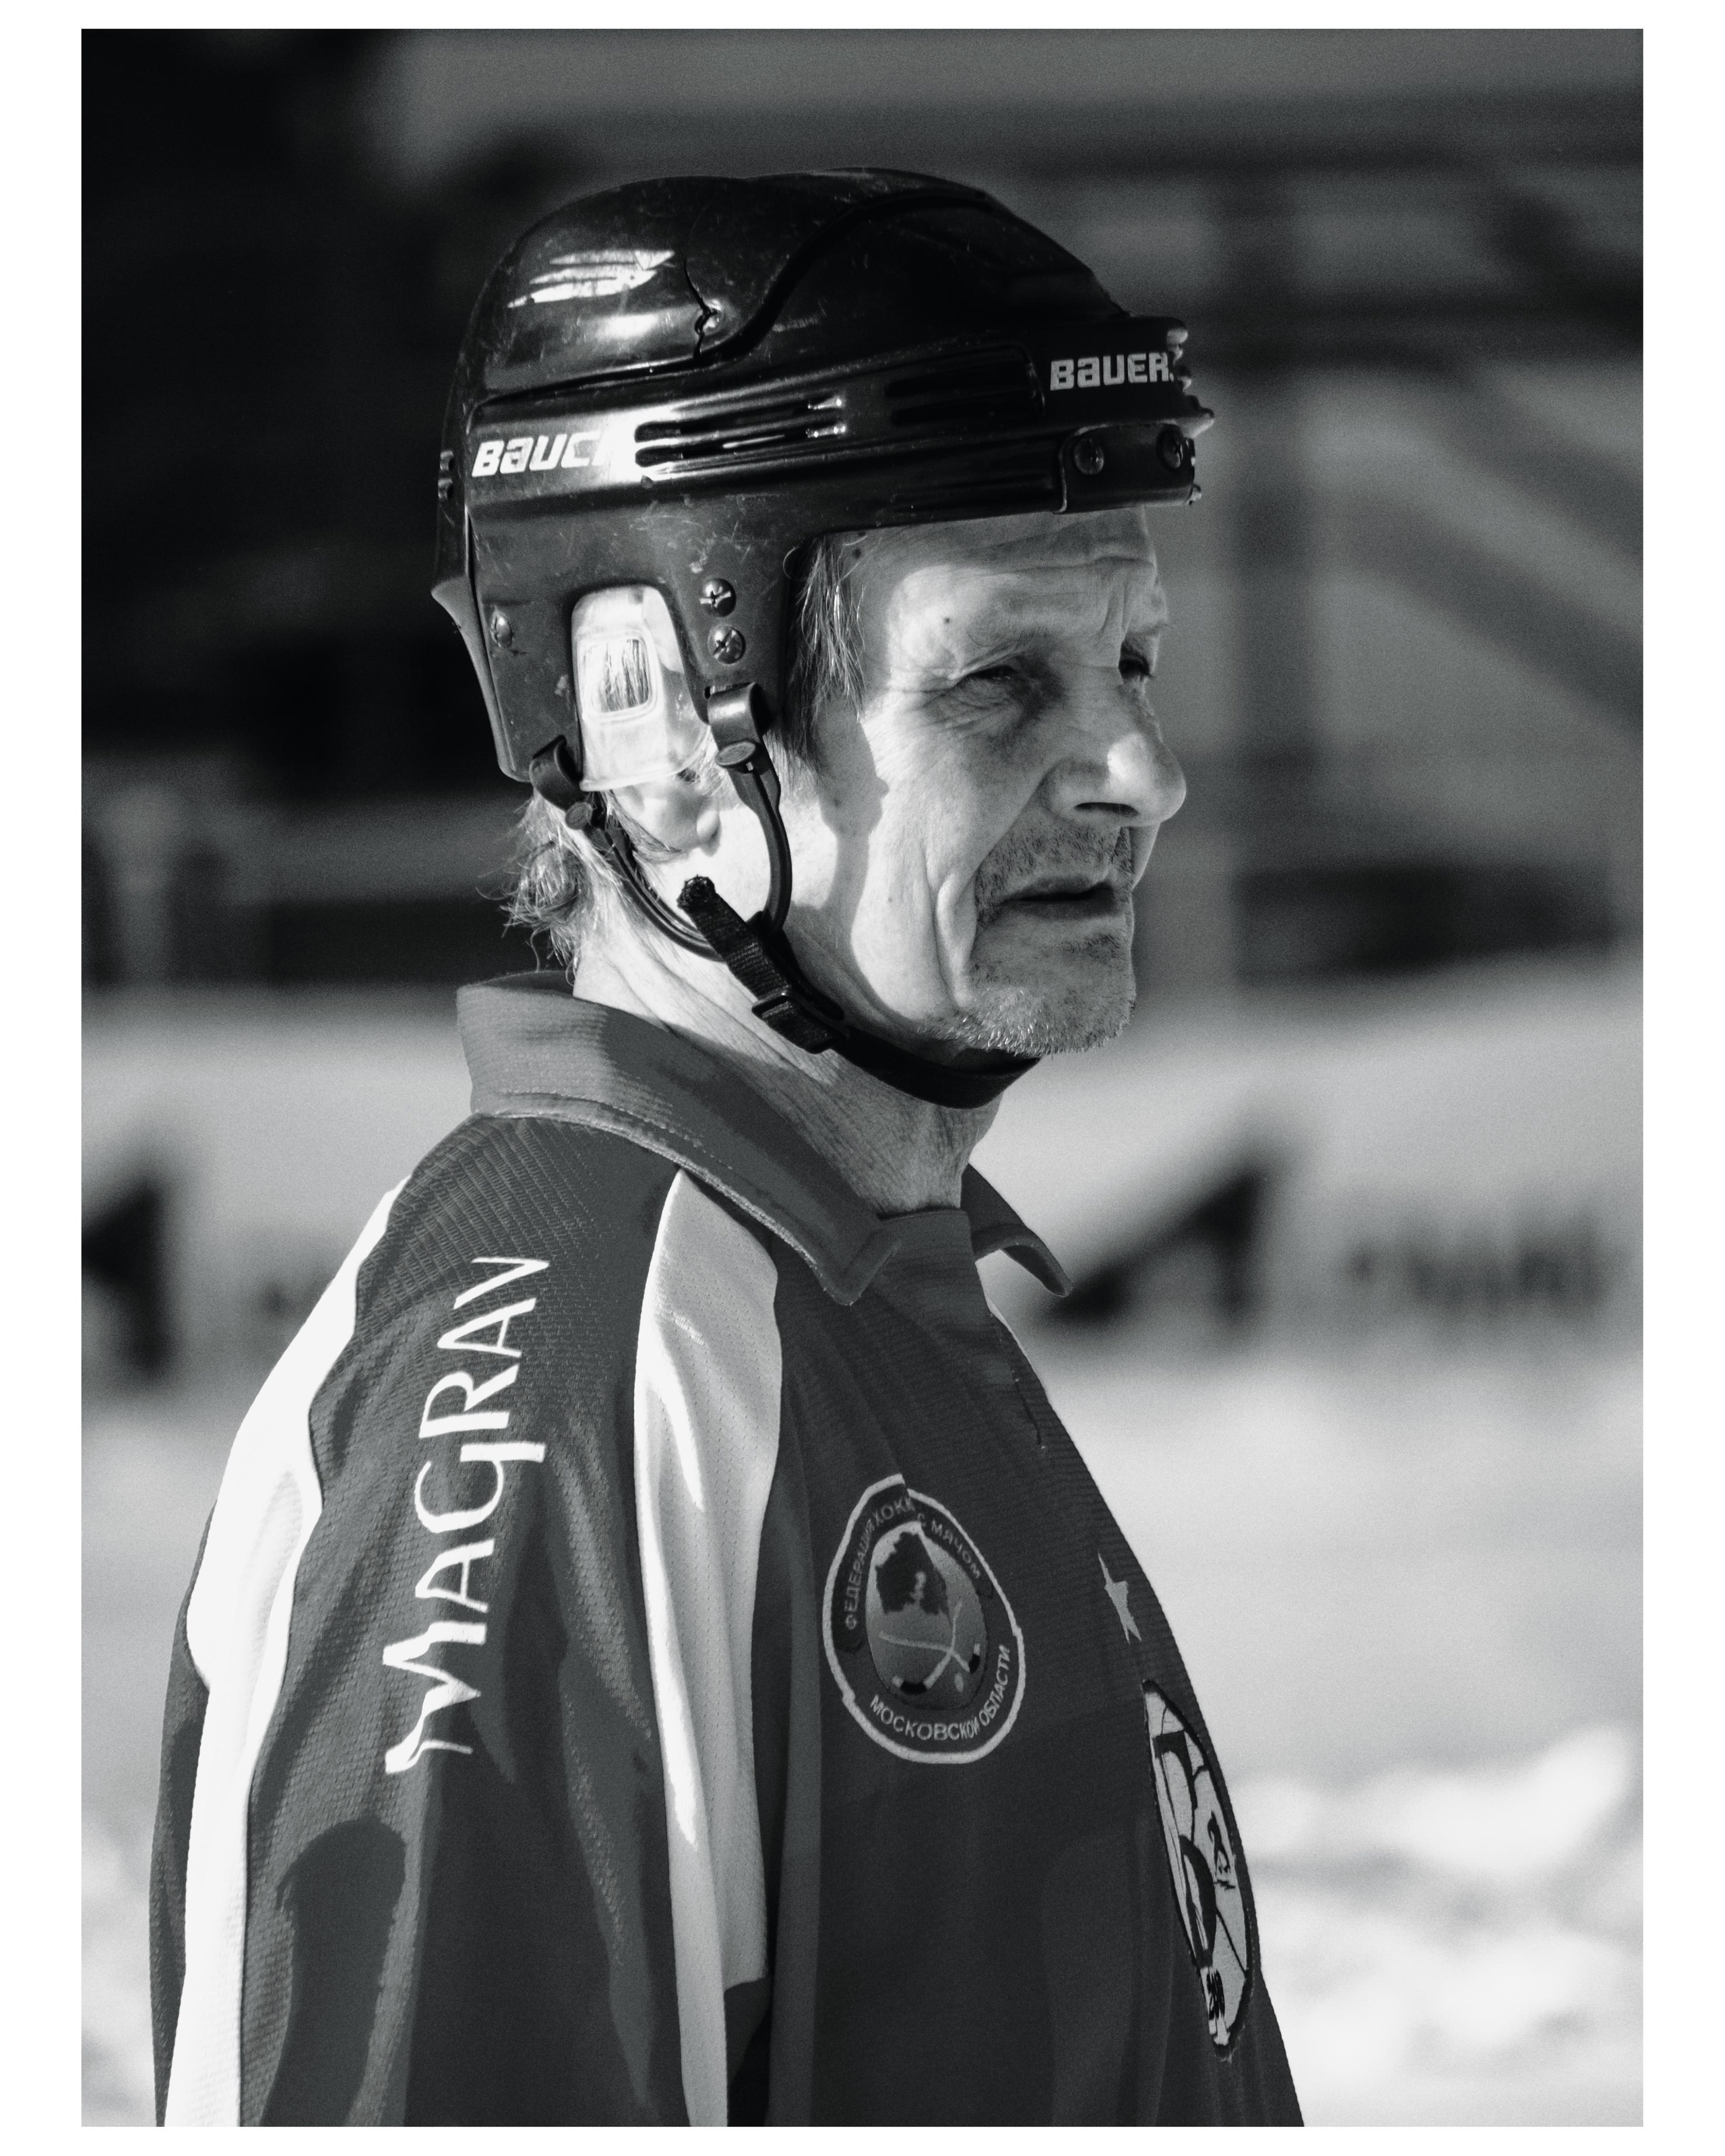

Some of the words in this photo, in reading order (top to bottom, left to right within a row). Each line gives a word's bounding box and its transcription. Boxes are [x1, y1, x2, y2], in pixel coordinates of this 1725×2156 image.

[1050, 352, 1170, 391] BAUER
[383, 1256, 550, 1774] MAGRAV
[931, 1518, 980, 1579] МЯЧОМ
[870, 1694, 980, 1741] МОСКОВСКОЙ
[978, 1644, 1011, 1726] ОБЛАСТИ
